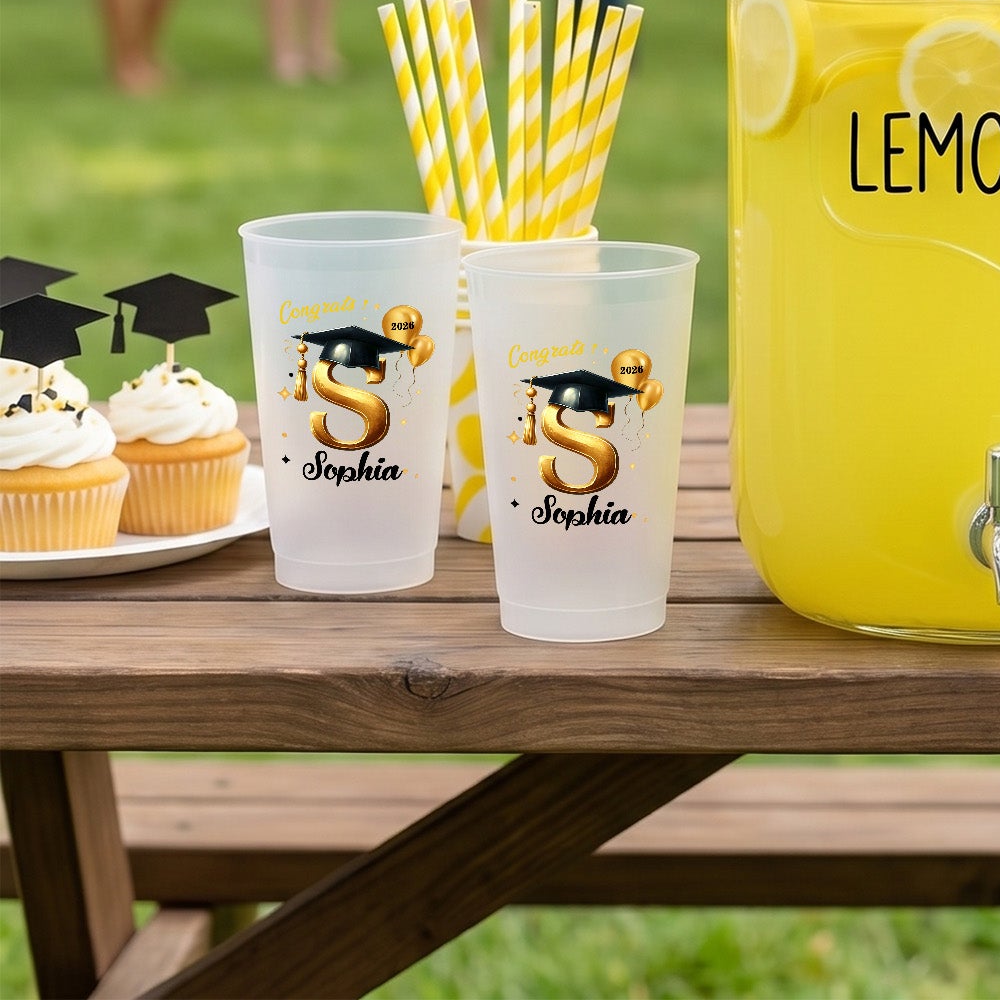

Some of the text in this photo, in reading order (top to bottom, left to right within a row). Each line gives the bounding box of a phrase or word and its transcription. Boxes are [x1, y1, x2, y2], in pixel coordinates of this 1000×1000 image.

[390, 321, 415, 331] 2026
[619, 365, 644, 375] 2026
[309, 357, 391, 451] S
[538, 401, 620, 495] S
[302, 450, 403, 487] Sophia
[531, 494, 633, 531] Sophia
